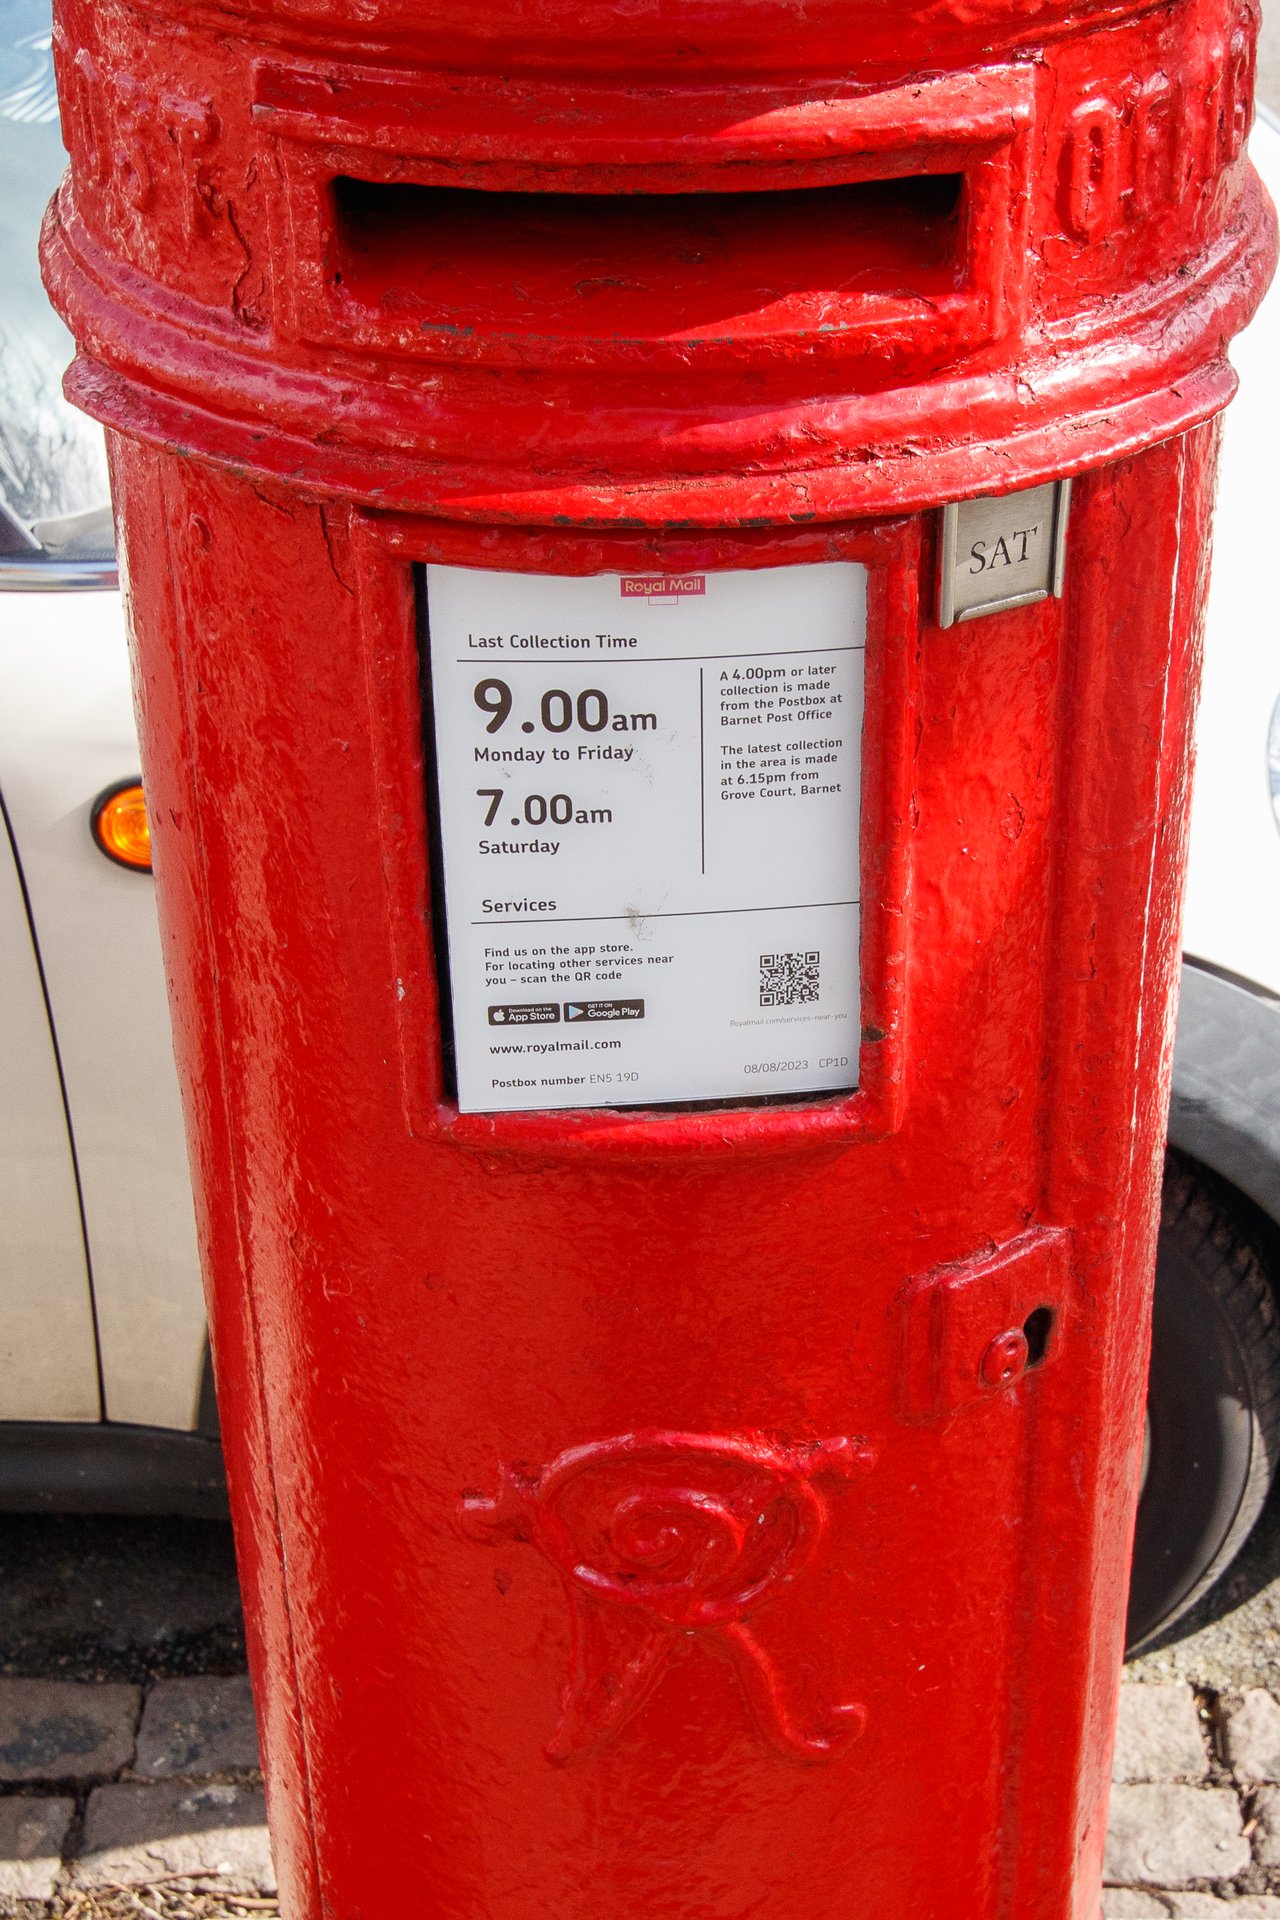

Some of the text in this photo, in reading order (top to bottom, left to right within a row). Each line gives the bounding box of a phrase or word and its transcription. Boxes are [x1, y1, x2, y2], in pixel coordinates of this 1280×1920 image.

[970, 526, 1037, 574] SAT
[625, 579, 700, 595] Royal Mail
[469, 634, 637, 648] Last Collection Time
[720, 671, 728, 681] A
[732, 667, 785, 681] 4.00pm
[808, 666, 836, 675] later
[721, 680, 830, 696] collection is made
[474, 678, 657, 734] 9.00am
[720, 694, 842, 711] from the Postbox at
[721, 709, 832, 726] Barnet Post Office
[475, 745, 633, 764] Monday to Friday
[721, 738, 842, 755] The latest collection
[721, 753, 837, 770] in the area is made
[721, 771, 819, 786] at 6.15pm from
[721, 784, 841, 800] Grove Court, Barnet
[476, 789, 612, 826] 7.00am
[479, 839, 560, 855] Saturday
[482, 898, 556, 913] Services
[485, 948, 510, 957] Find
[551, 946, 569, 955] the
[574, 946, 595, 955] app
[600, 944, 633, 953] store.
[486, 956, 674, 971] For locating other services near
[486, 978, 506, 987] you
[551, 973, 570, 982] the
[575, 972, 591, 981] QR
[596, 971, 622, 980] code
[509, 1012, 555, 1022] App Store
[588, 1007, 640, 1018] Google Play
[490, 1040, 621, 1054] www.royalmail.com
[744, 1057, 848, 1074] 08/08/2023 CP1D
[492, 1072, 639, 1088] Postbox number EN5 19D
